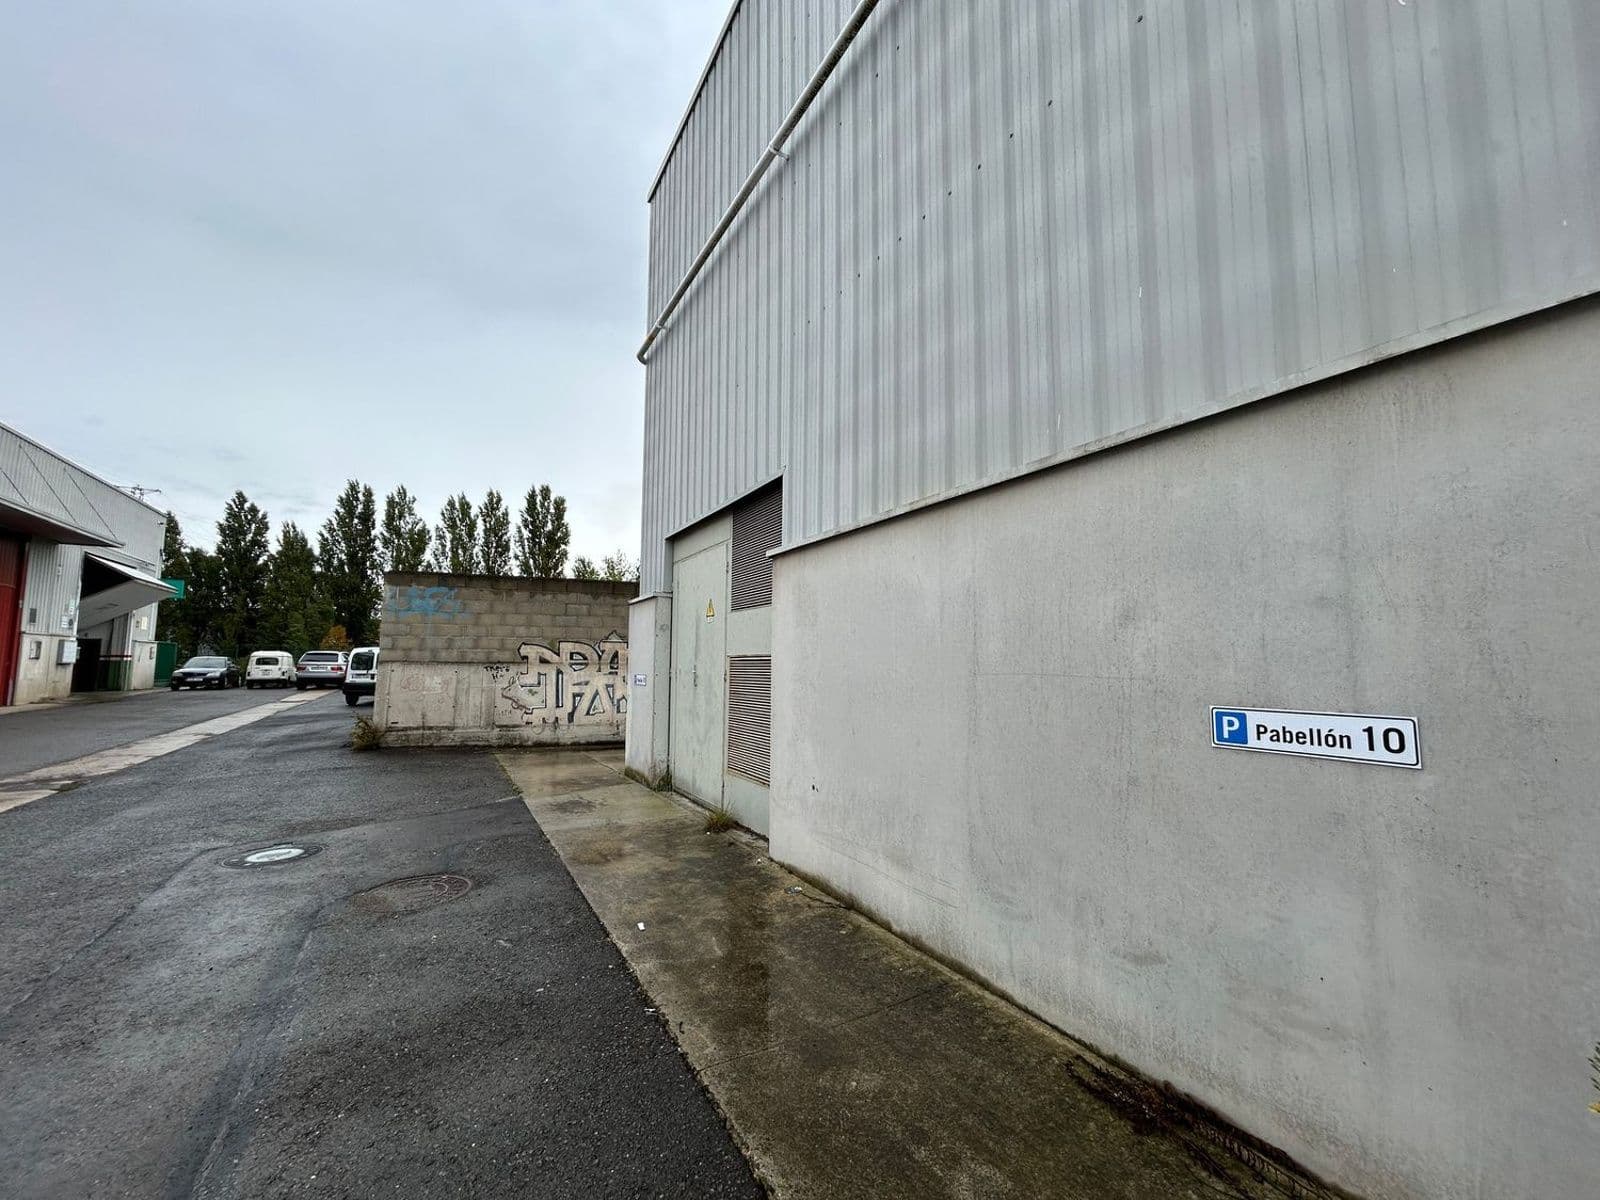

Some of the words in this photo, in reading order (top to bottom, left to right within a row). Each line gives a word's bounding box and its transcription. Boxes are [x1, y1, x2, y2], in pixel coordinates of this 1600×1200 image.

[1221, 716, 1240, 739] P
[1255, 724, 1352, 749] Pabellón
[1362, 726, 1406, 754] 10
